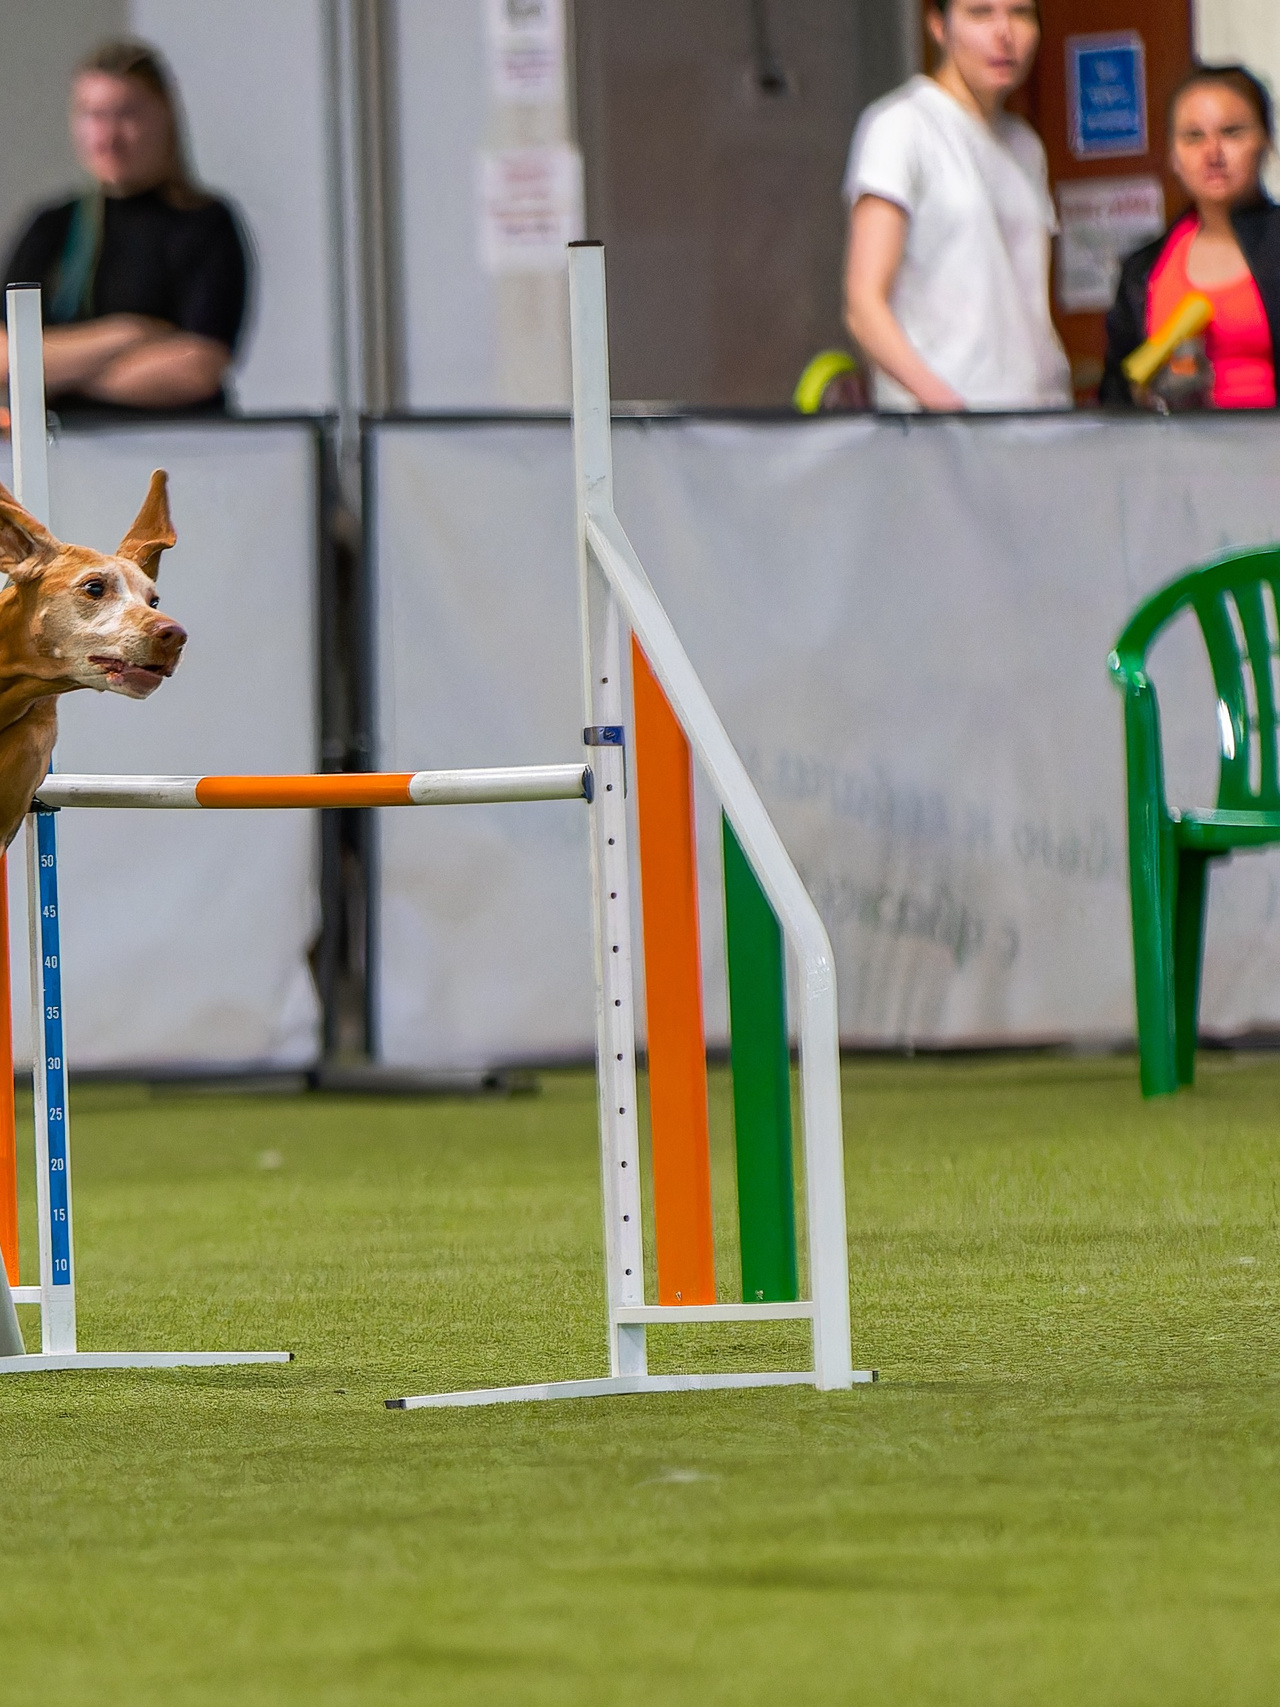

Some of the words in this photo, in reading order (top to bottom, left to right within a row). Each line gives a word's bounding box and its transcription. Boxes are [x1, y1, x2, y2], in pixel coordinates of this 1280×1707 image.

[41, 854, 54, 868] 50
[43, 905, 56, 918] 45
[45, 956, 57, 969] 40
[46, 1007, 59, 1020] 35
[48, 1058, 60, 1070] 30
[50, 1108, 62, 1120] 25
[51, 1158, 64, 1171] 20
[53, 1209, 66, 1222] 15
[55, 1258, 68, 1271] 10
